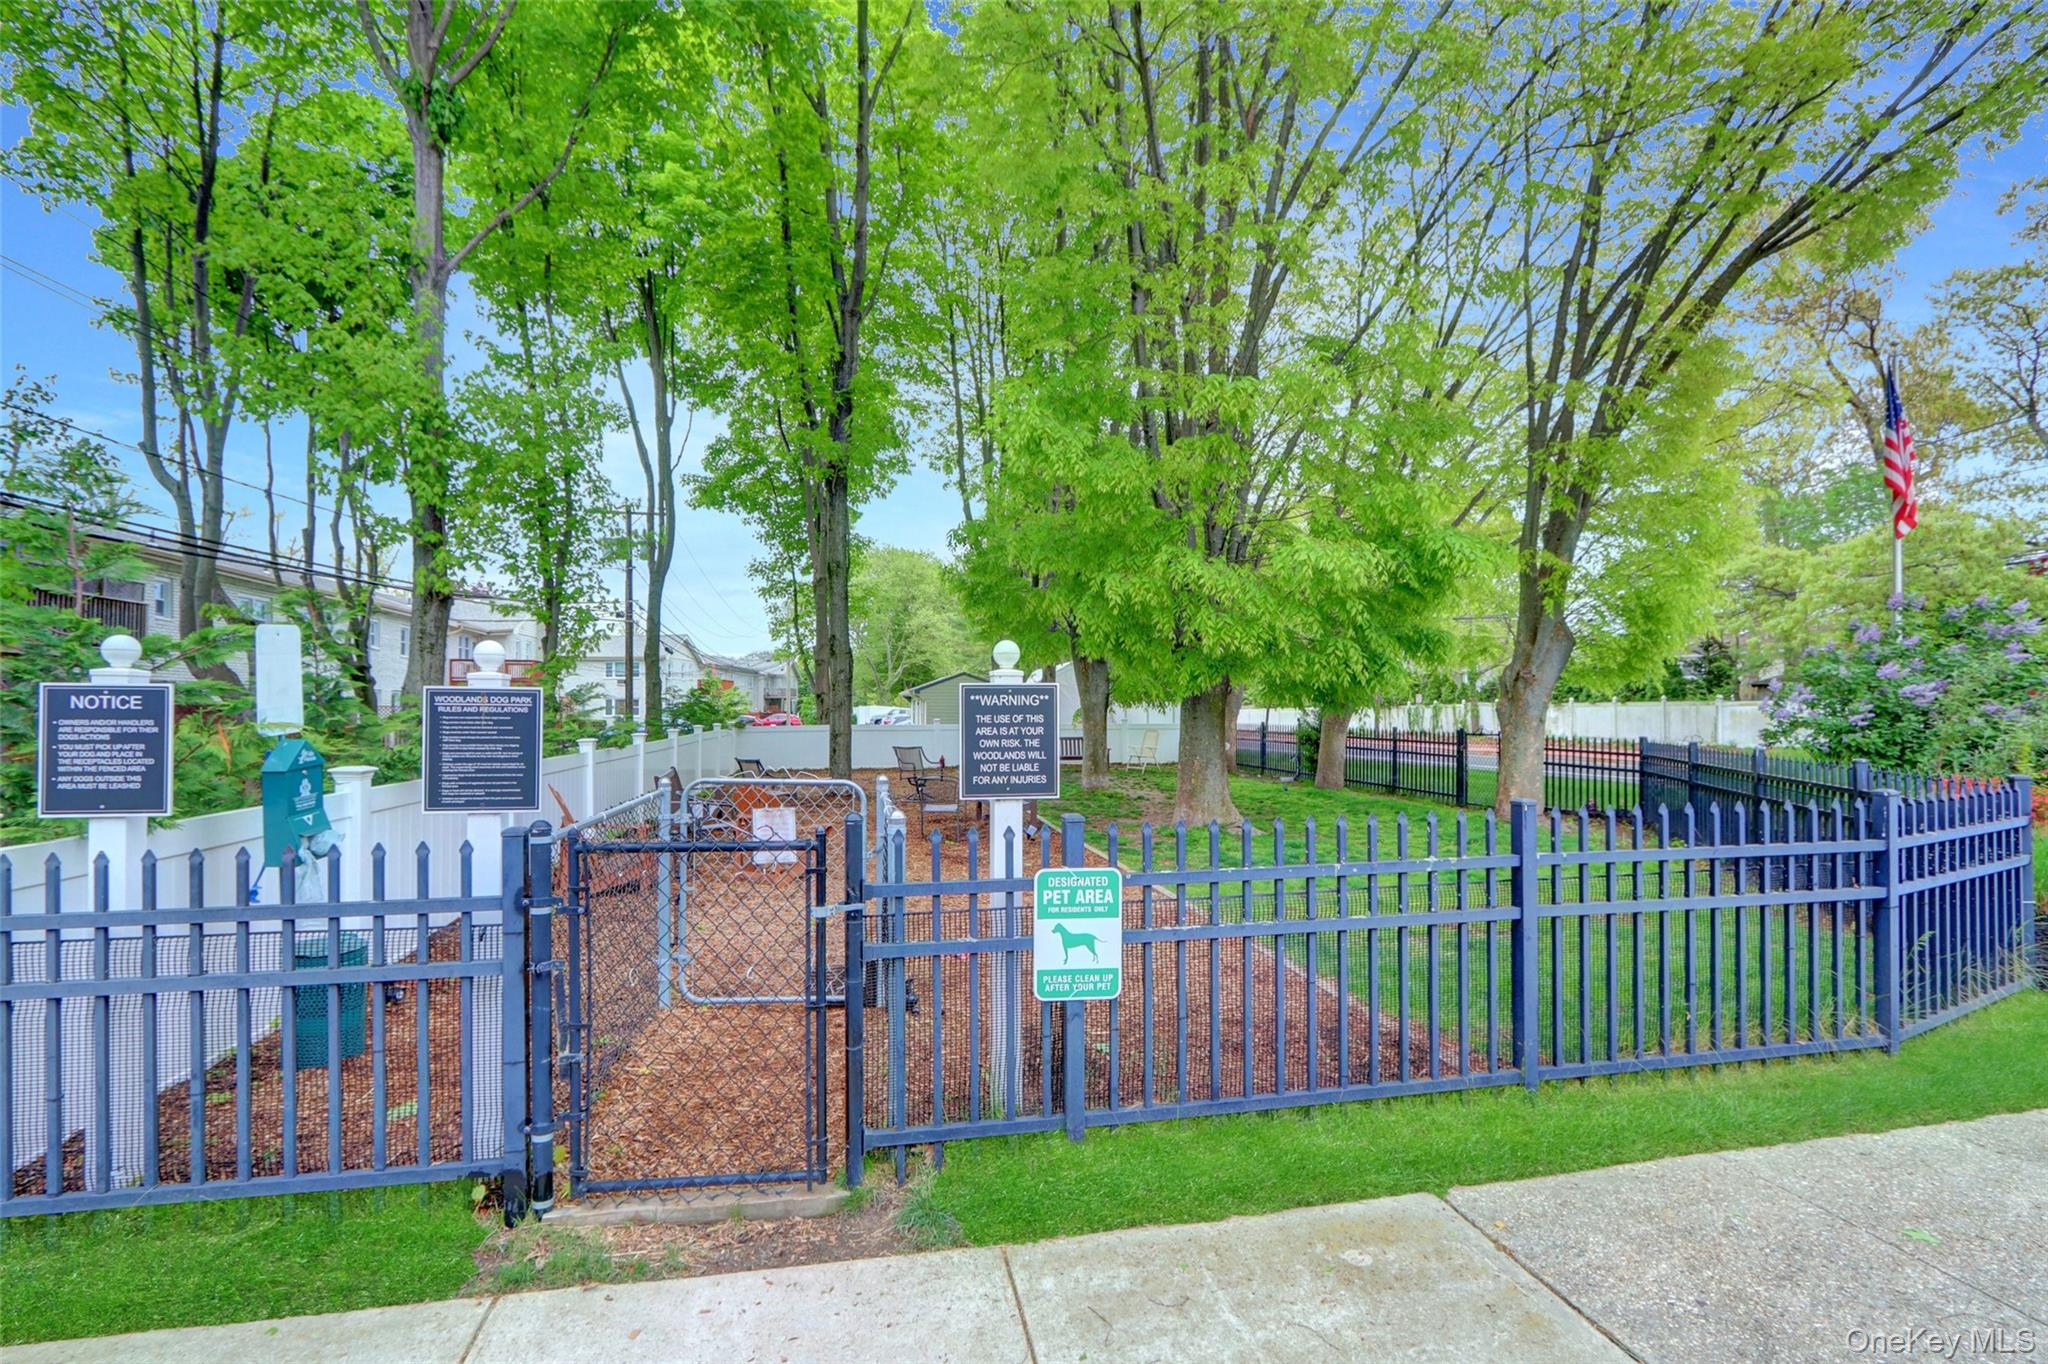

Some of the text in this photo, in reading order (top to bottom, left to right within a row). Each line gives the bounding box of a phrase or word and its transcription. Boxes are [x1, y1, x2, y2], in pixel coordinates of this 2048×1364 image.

[70, 695, 142, 709] NOTICE
[976, 715, 1044, 723] THE USE OF THIS
[1021, 727, 1044, 735] YOUR
[1001, 739, 1022, 748] RISK.
[973, 752, 1026, 760] WOODLANDS
[980, 764, 998, 772] NOT
[1010, 776, 1046, 784] INJURIES
[1048, 876, 1108, 887] DESIGNATED
[1043, 889, 1114, 904] PET AREA
[1043, 975, 1072, 984] PLEASE
[1045, 982, 1112, 992] AFTER YOUR PET
